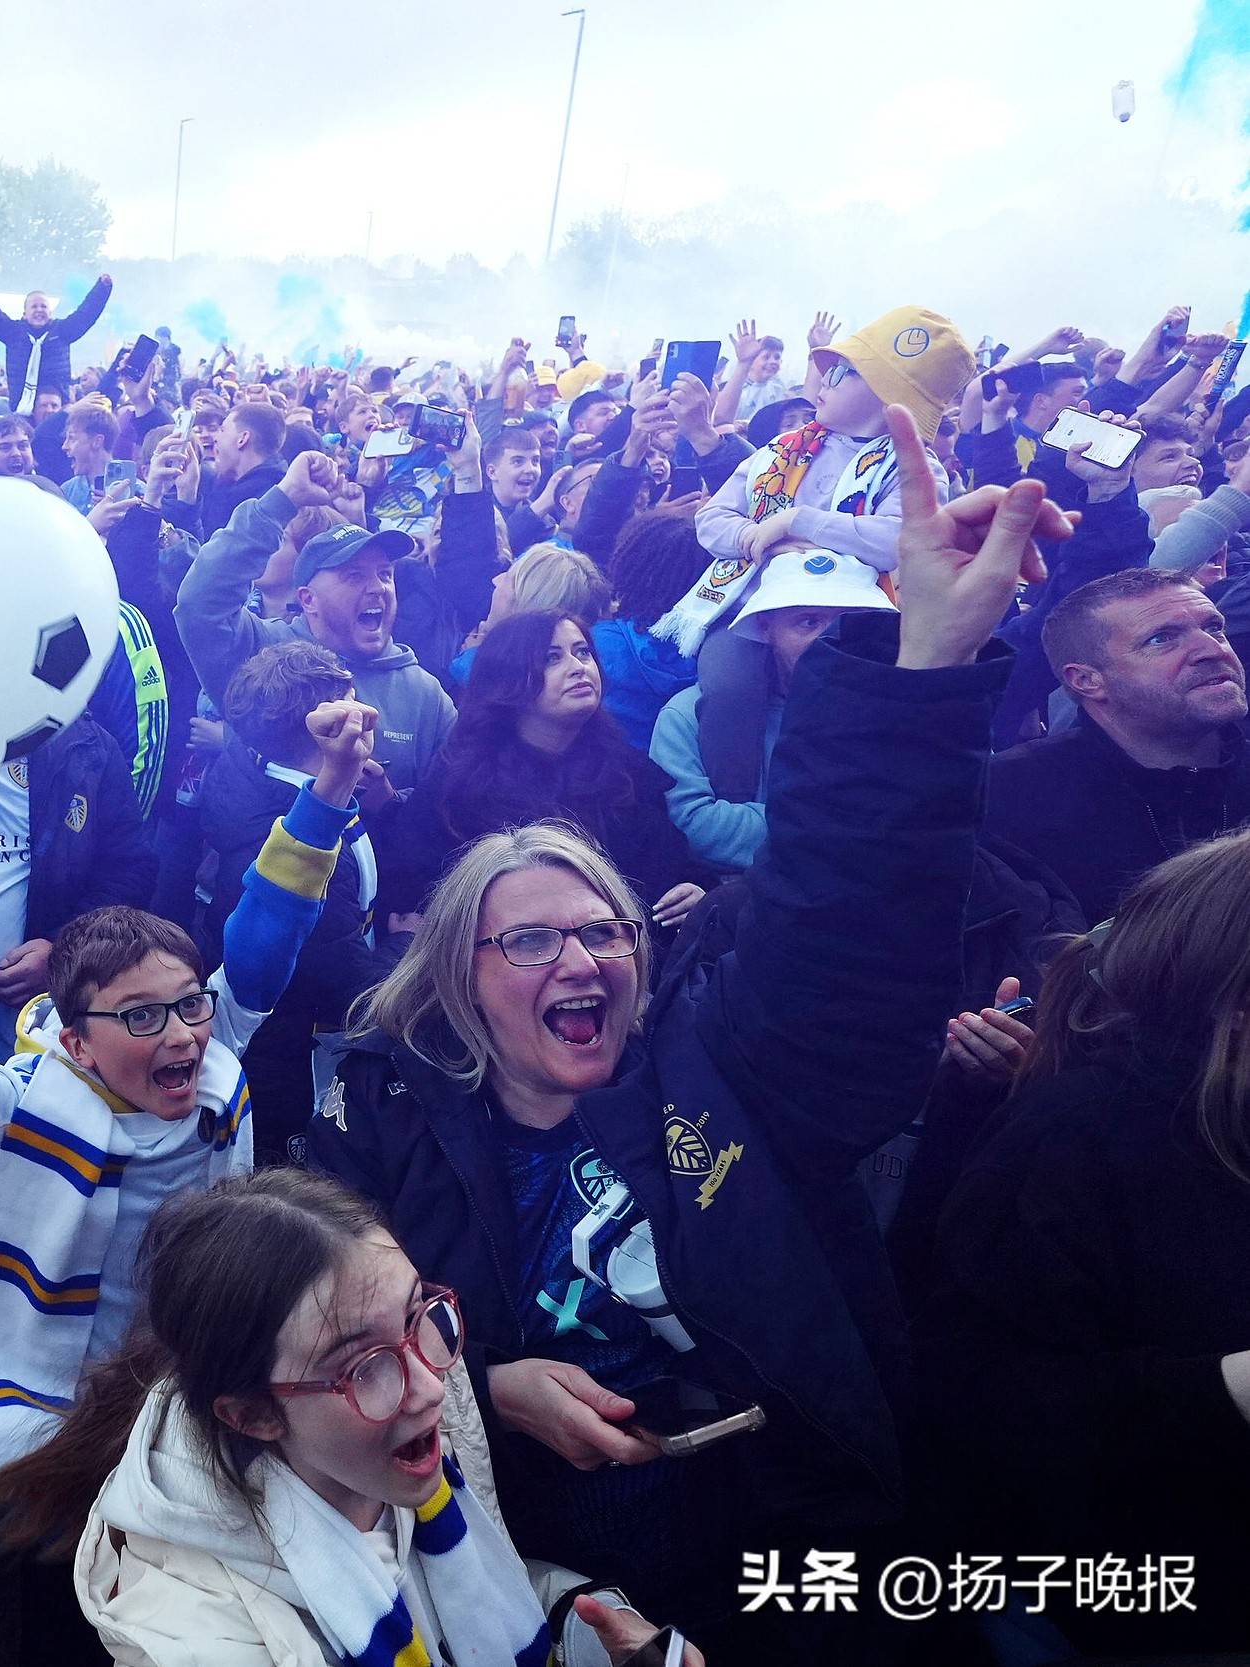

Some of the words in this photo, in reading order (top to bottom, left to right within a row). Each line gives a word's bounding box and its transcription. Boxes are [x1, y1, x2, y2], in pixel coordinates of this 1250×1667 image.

[662, 1103, 675, 1115] ED
[696, 1111, 711, 1129] 2019
[716, 1159, 727, 1177] YEARS
